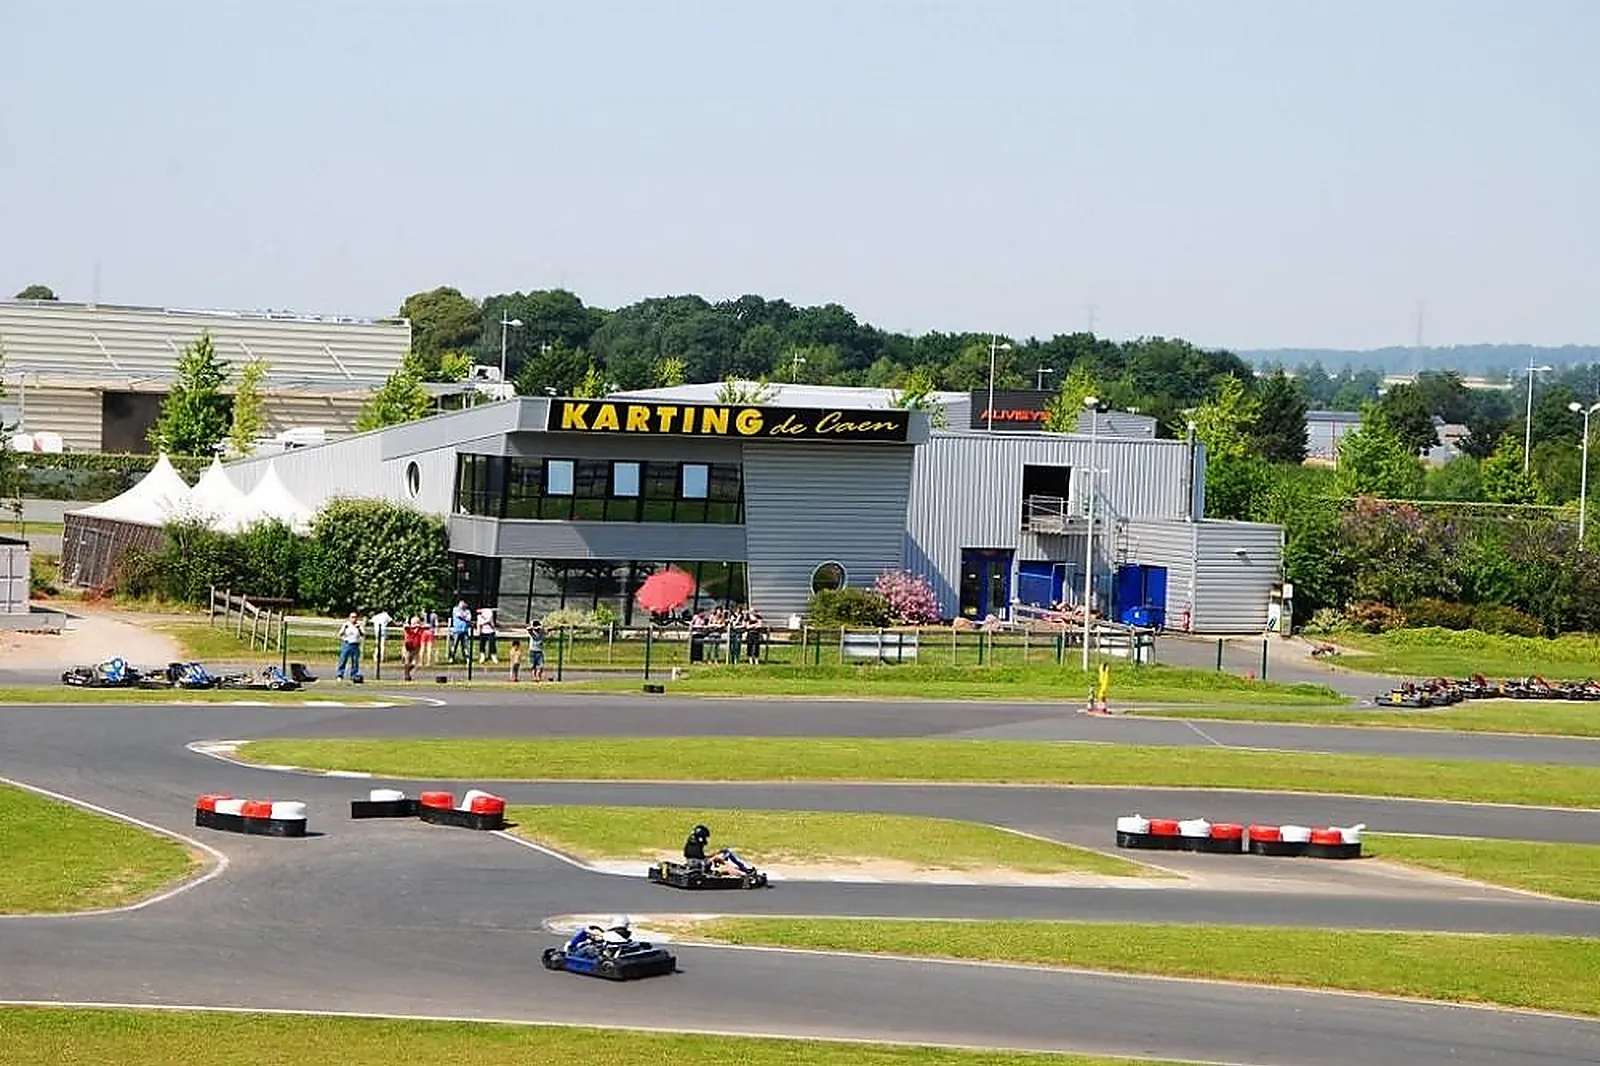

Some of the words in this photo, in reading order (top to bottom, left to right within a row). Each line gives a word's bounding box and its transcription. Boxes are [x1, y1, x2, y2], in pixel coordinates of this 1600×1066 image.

[561, 402, 764, 435] KARTING
[770, 413, 807, 435] de
[814, 411, 898, 434] Caen
